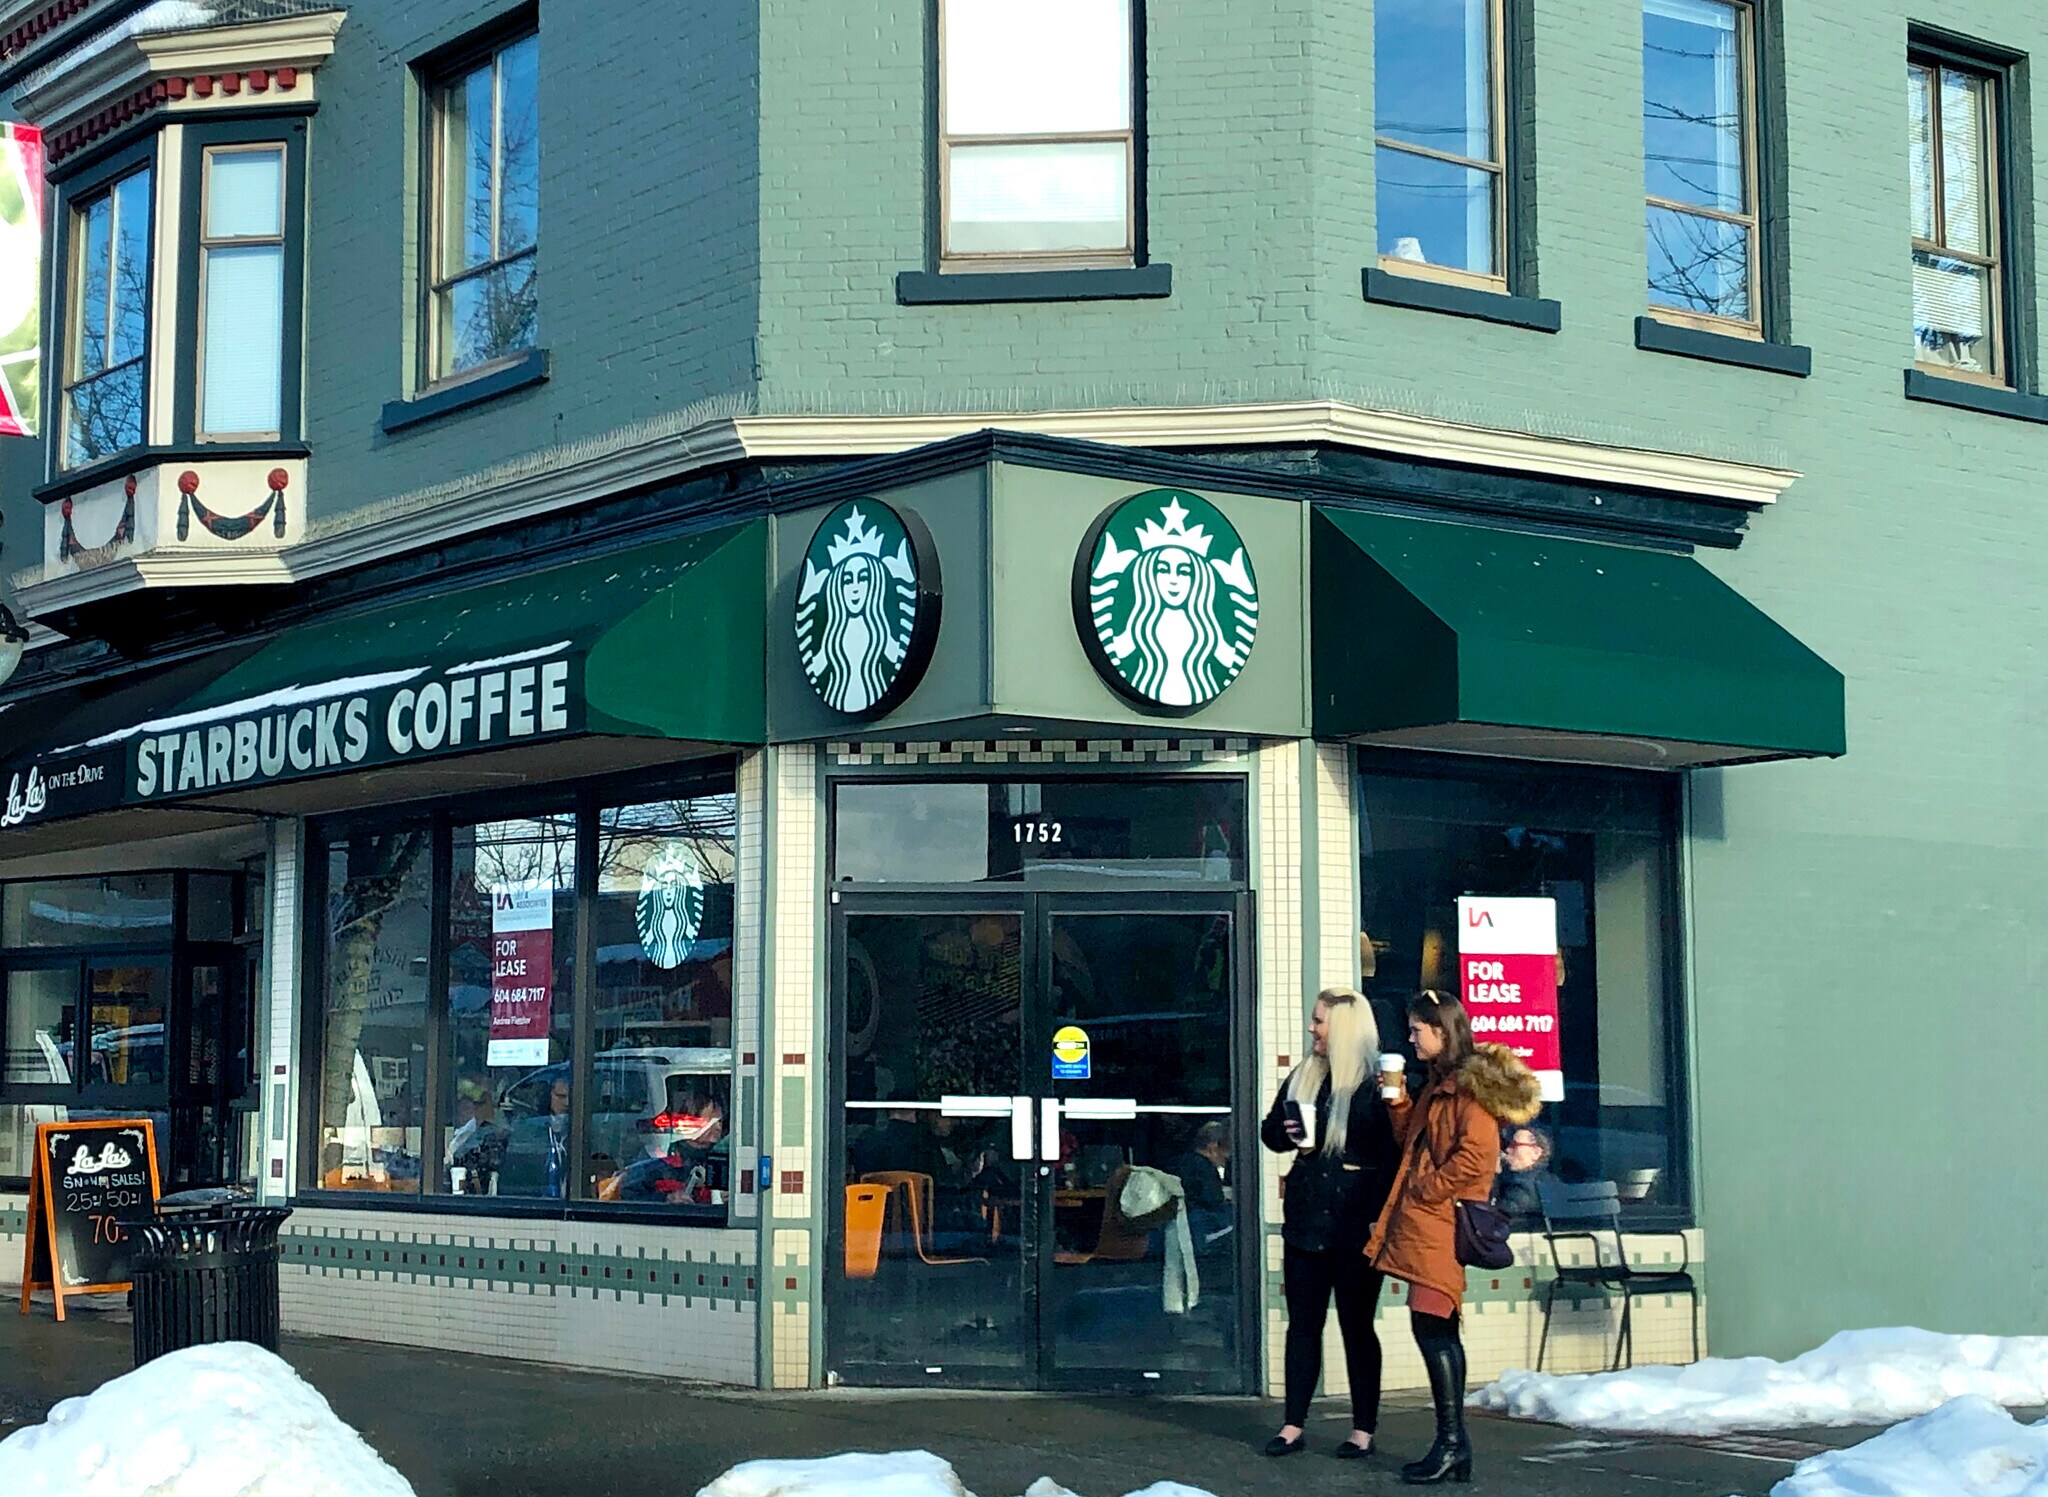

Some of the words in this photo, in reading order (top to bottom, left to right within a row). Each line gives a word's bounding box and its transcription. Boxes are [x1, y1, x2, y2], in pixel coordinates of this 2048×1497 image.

[137, 698, 370, 797] STARBUCKS
[387, 660, 569, 755] COFFEE
[48, 775, 60, 789] ON
[62, 771, 76, 787] THE
[1013, 822, 1062, 843] 1752
[495, 940, 517, 957] FOR
[495, 959, 527, 977] LEASE
[1467, 961, 1505, 981] FOR
[494, 988, 510, 1004] 604
[511, 987, 527, 1003] 684
[528, 986, 546, 1002] 7117
[1468, 983, 1522, 1004] LEASE
[1470, 1015, 1497, 1033] 604
[1498, 1015, 1524, 1033] 684
[111, 1171, 146, 1187] SALES!
